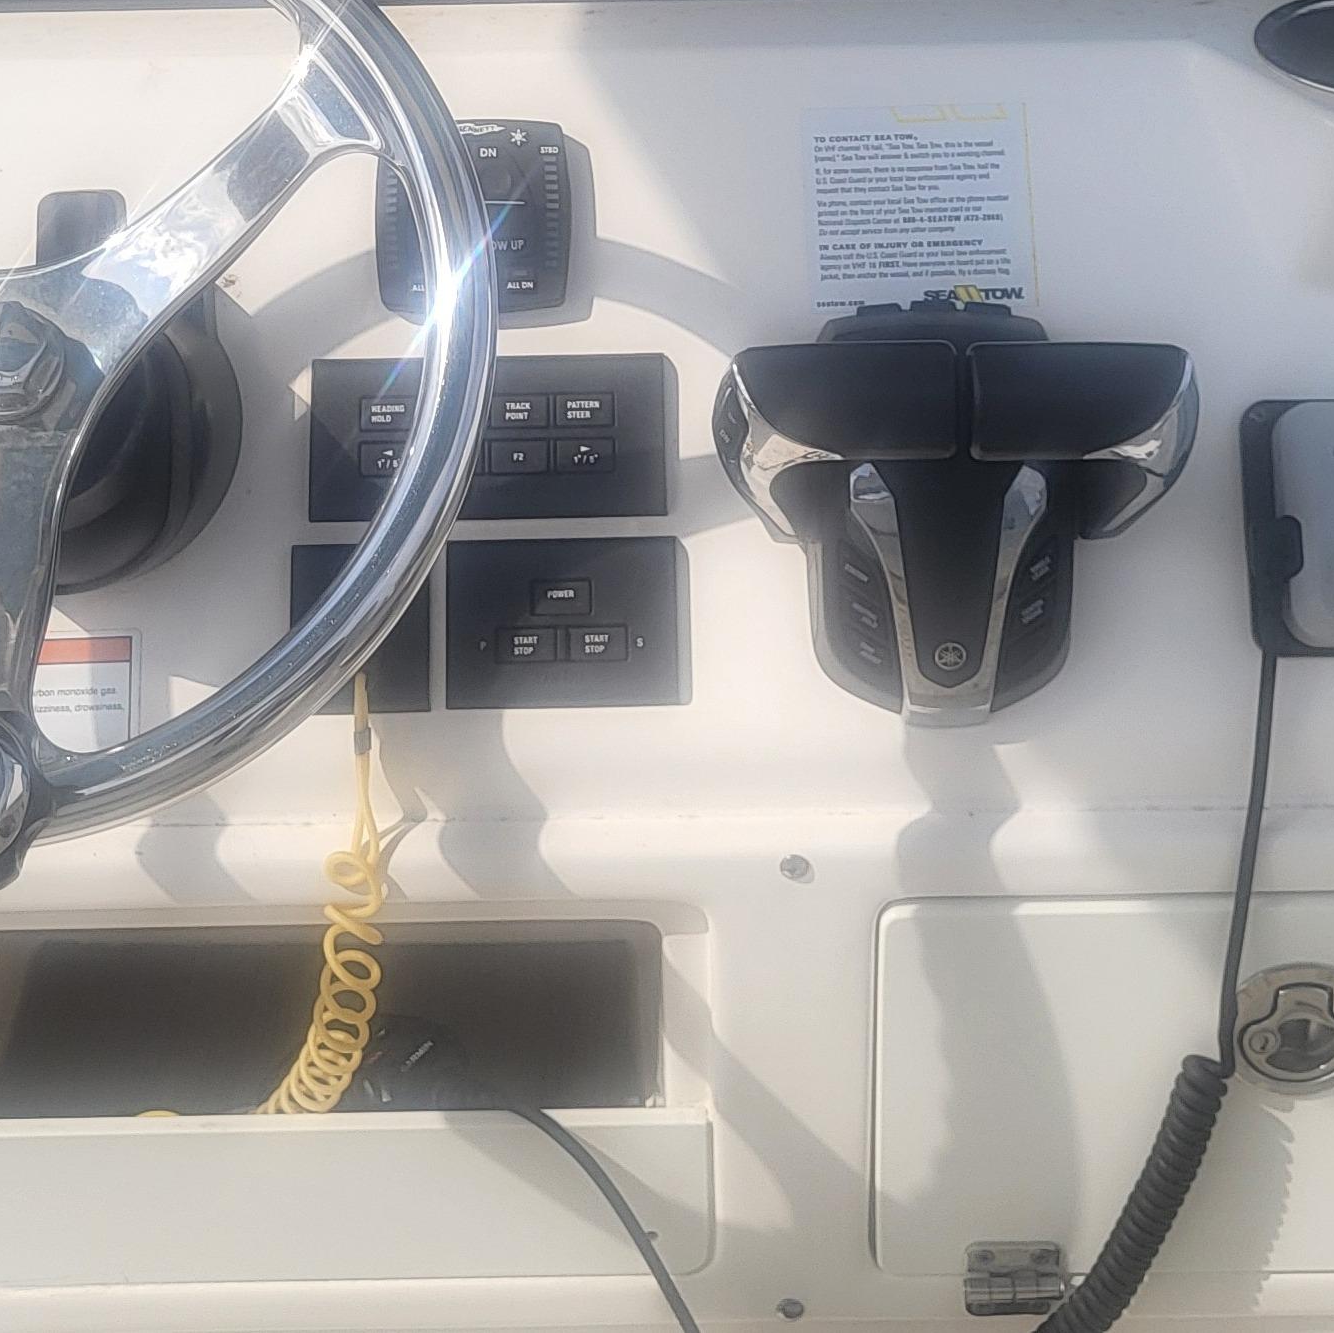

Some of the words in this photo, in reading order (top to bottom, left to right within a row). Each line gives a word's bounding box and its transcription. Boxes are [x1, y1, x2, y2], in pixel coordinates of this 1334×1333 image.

[829, 135, 871, 143] CONTACT
[479, 148, 497, 158] DN
[540, 146, 559, 154] STBD
[510, 239, 524, 250] UP
[926, 239, 983, 247] EMERGENCY
[507, 281, 520, 289] ALL
[521, 281, 534, 289] DN
[923, 289, 960, 302] SEA
[371, 404, 405, 414] HEADING
[505, 401, 531, 411] TRACK
[566, 400, 600, 409] PATTERN
[371, 414, 392, 424] HOLD
[505, 411, 529, 421] POINT
[567, 410, 591, 419] STEER
[512, 452, 524, 462] F2
[547, 589, 575, 599] POWER
[513, 636, 539, 645] START
[584, 634, 610, 644] START
[636, 637, 644, 648] S
[479, 640, 487, 651] P
[513, 646, 534, 655] STOP
[584, 644, 605, 654] STOP
[35, 688, 55, 697] rbon
[57, 687, 99, 696] monoxide
[35, 705, 73, 714] izziness,
